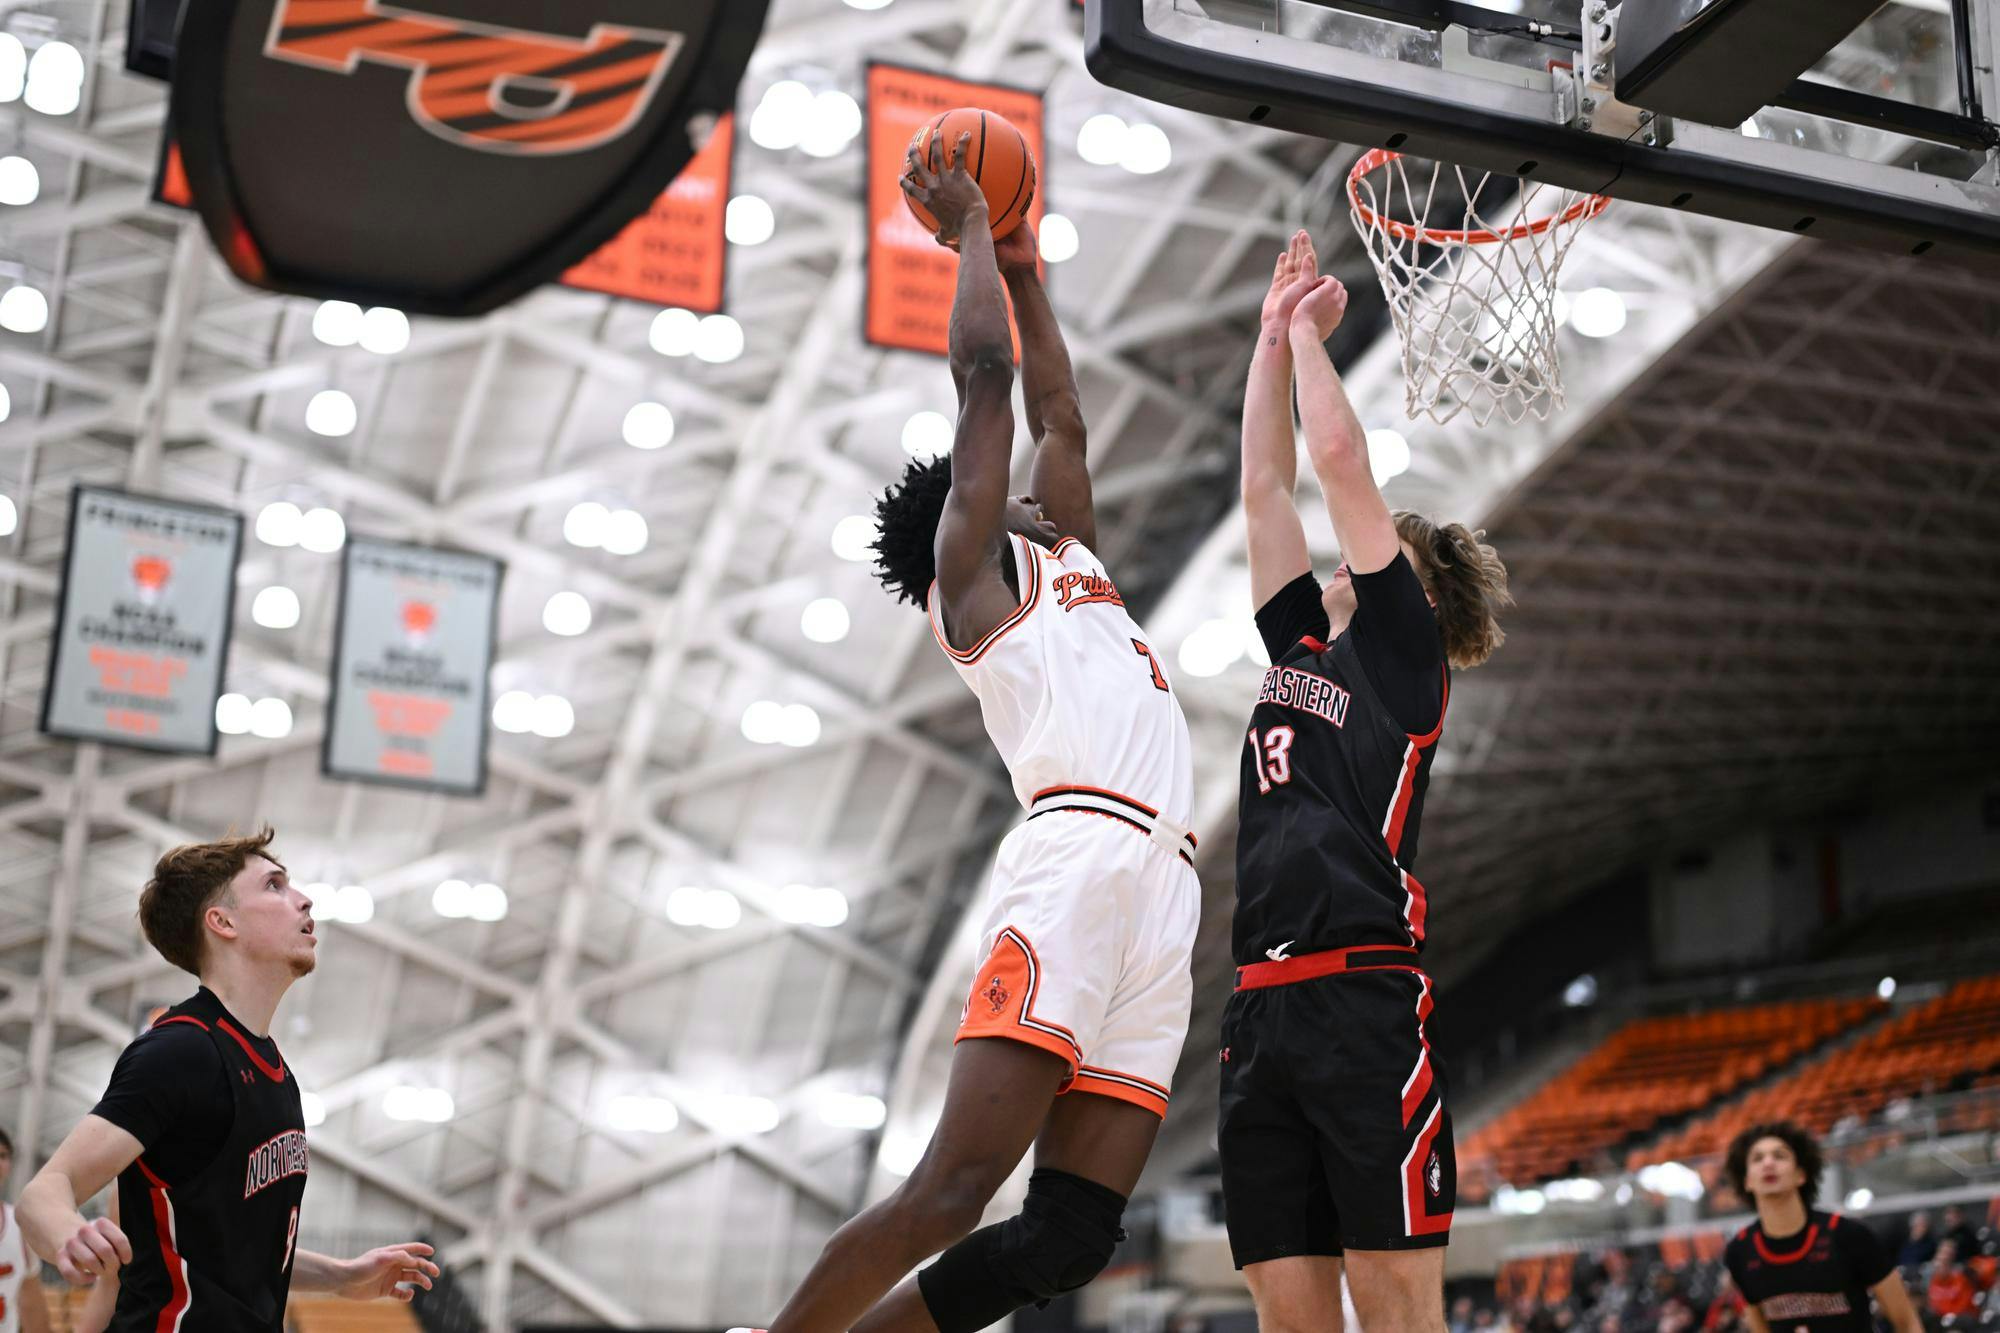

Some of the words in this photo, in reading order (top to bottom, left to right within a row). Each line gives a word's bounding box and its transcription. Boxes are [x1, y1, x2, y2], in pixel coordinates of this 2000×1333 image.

[263, 0, 685, 155] P
[1130, 637, 1169, 693] 7
[1248, 725, 1295, 796] 13
